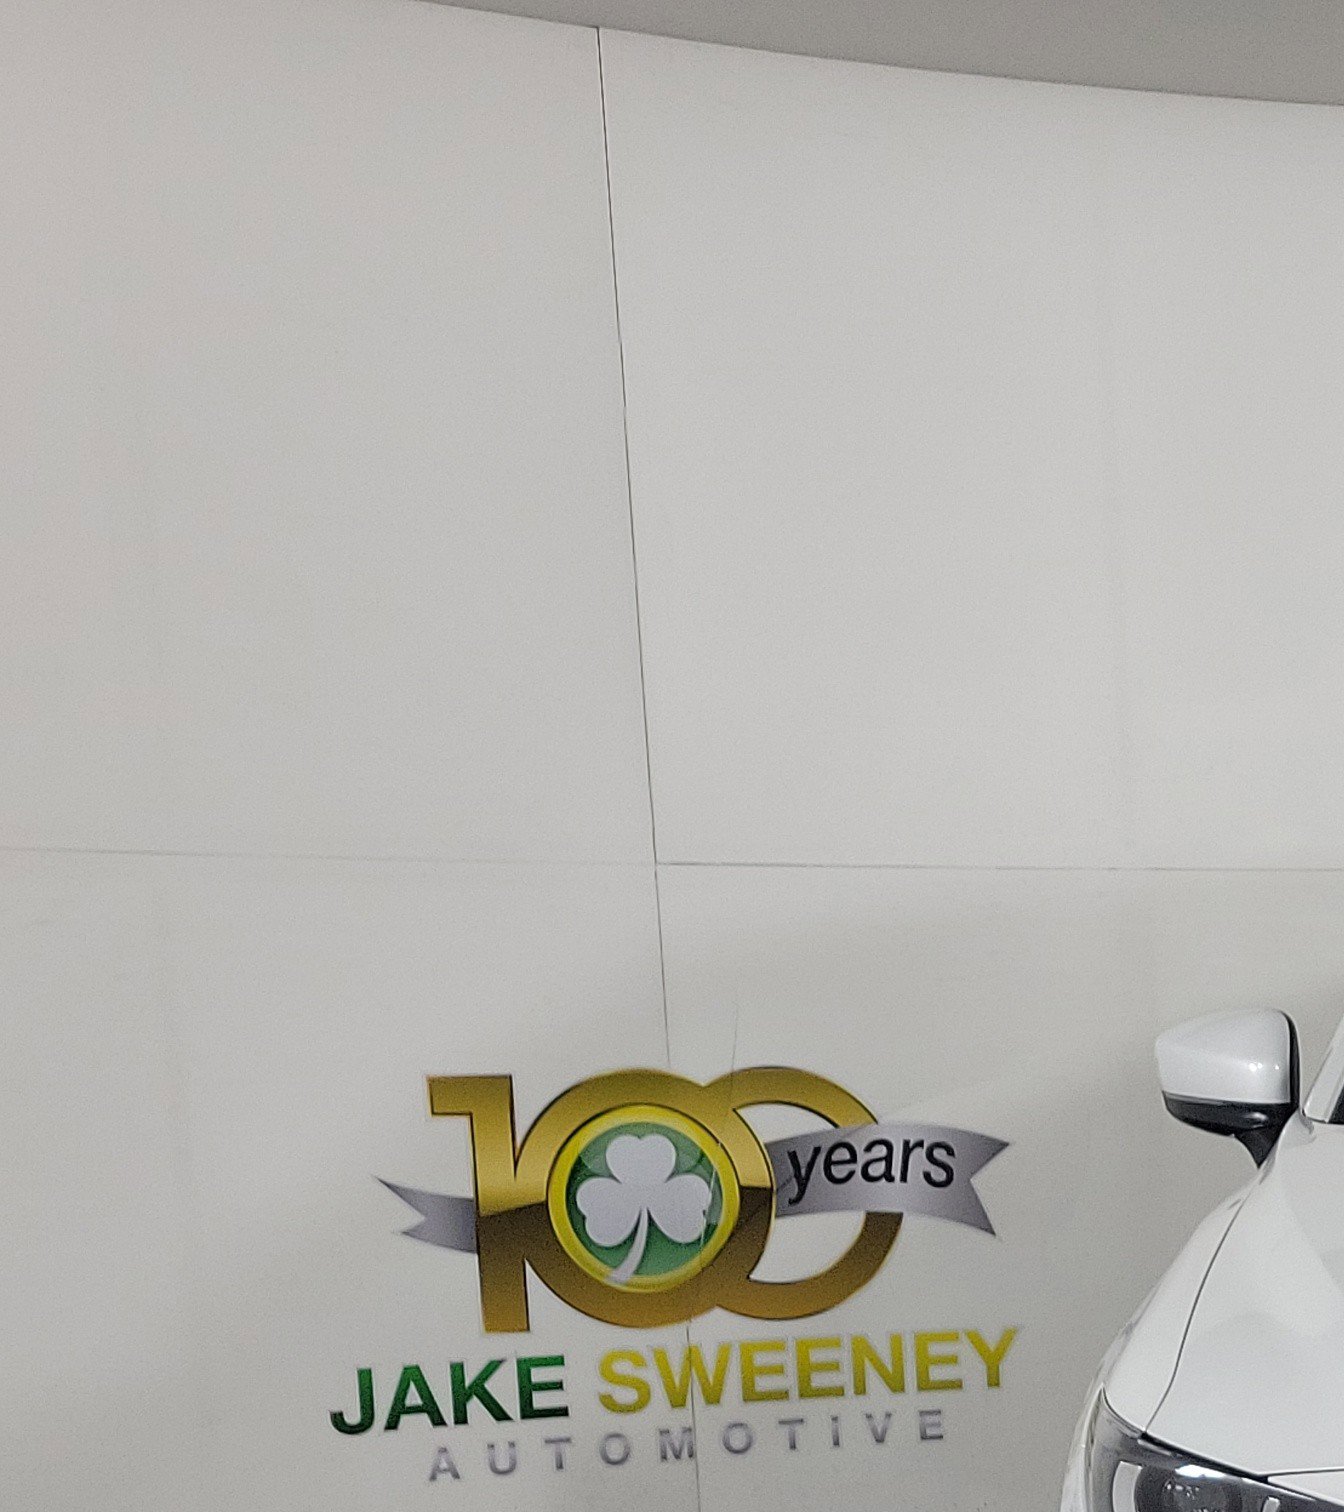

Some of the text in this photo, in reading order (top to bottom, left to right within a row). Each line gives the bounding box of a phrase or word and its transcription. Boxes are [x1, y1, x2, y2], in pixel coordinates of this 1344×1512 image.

[787, 1135, 956, 1205] years
[329, 1328, 1019, 1435] JAKE SWEENEY
[428, 1409, 944, 1482] AUTOMOTIVE
